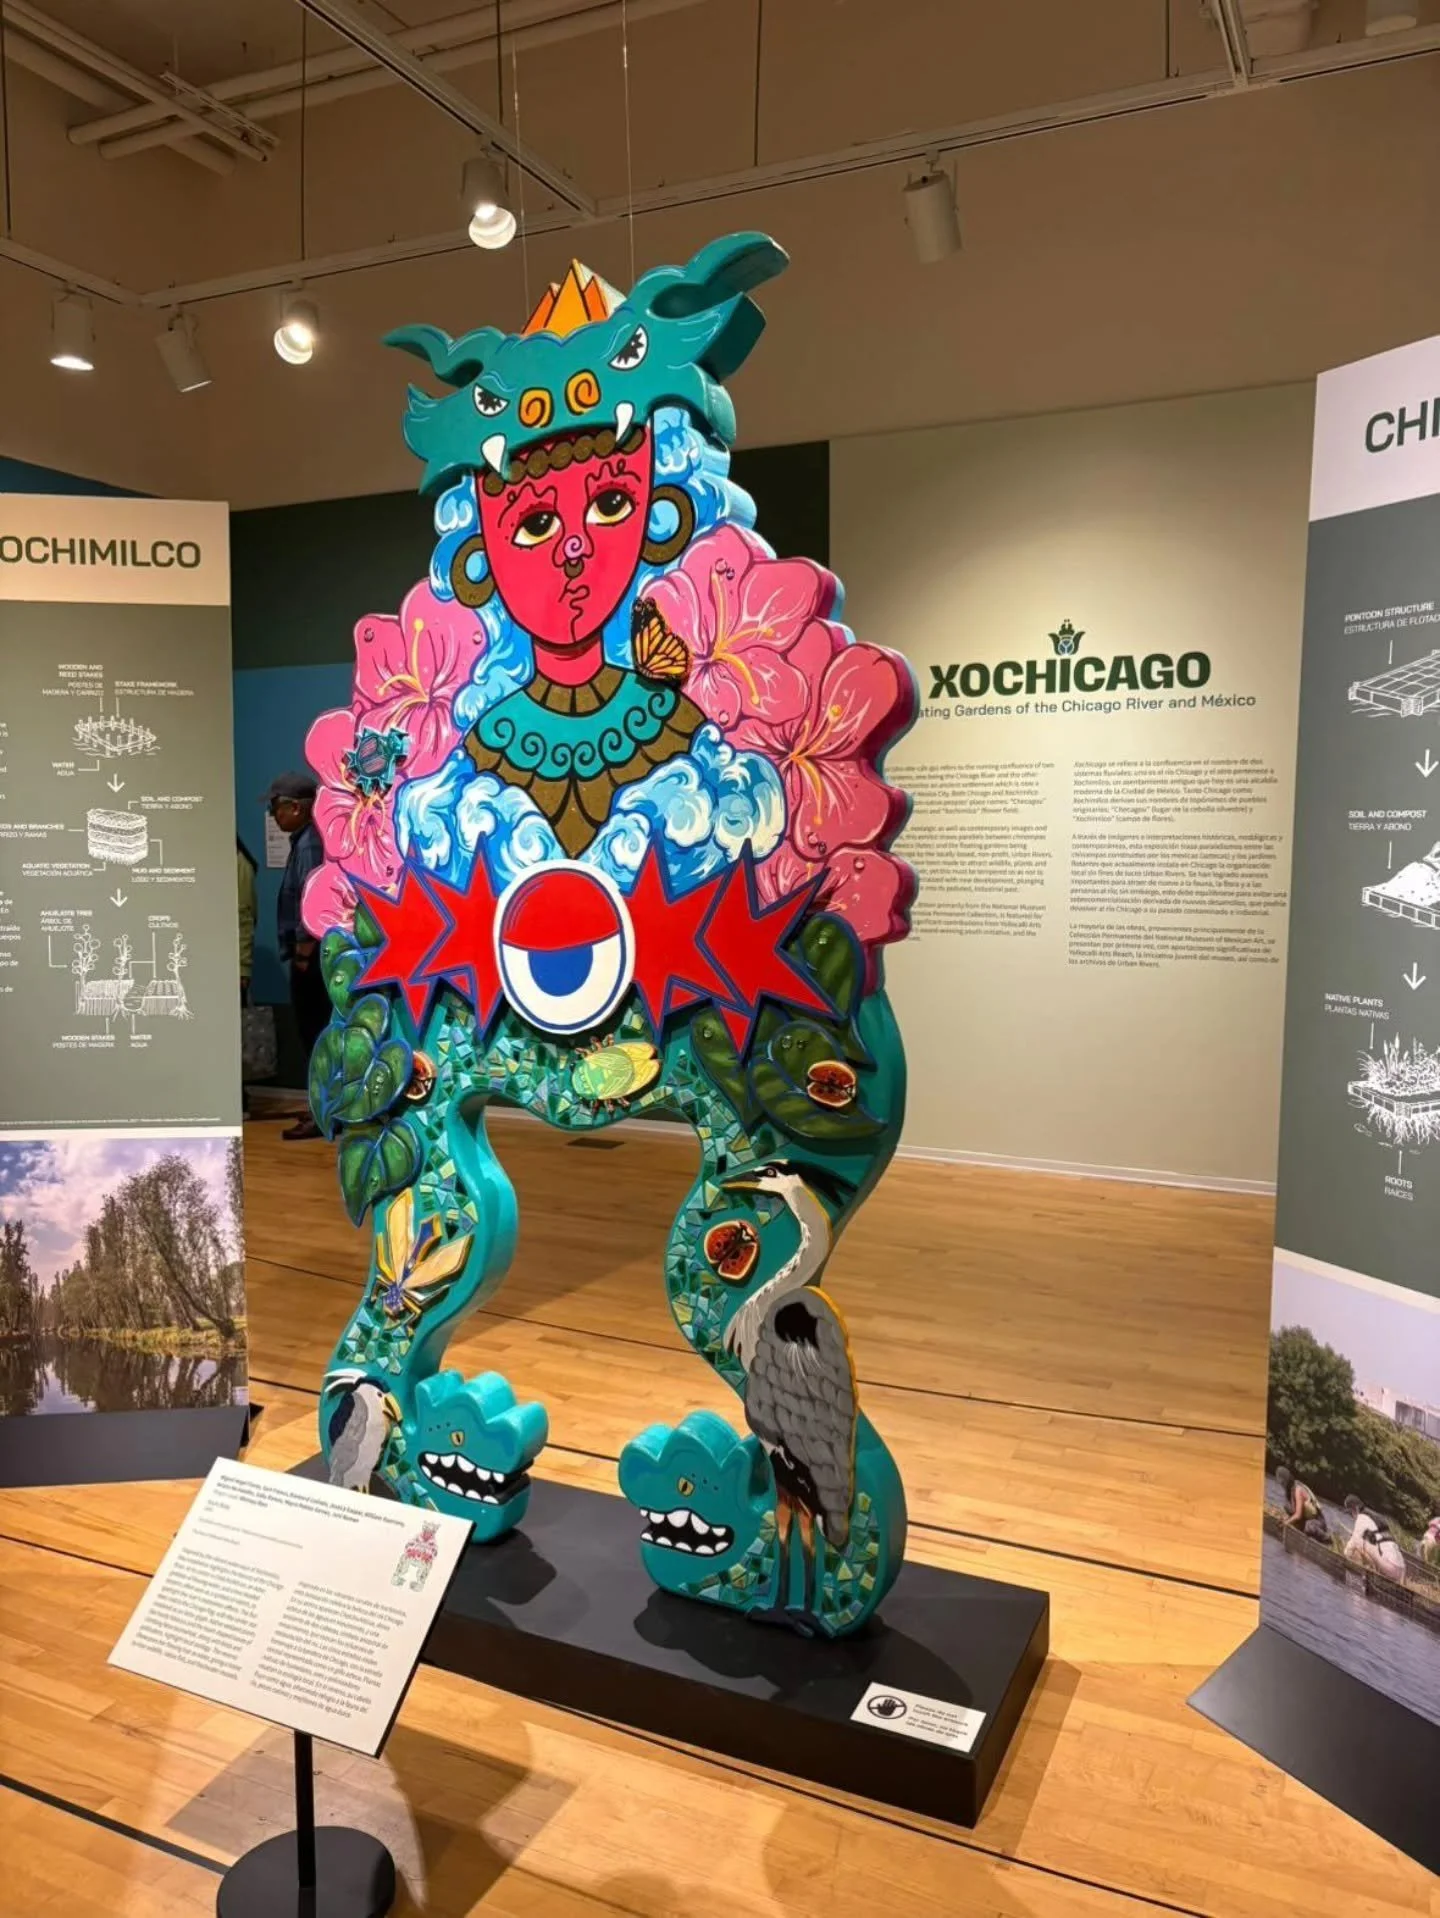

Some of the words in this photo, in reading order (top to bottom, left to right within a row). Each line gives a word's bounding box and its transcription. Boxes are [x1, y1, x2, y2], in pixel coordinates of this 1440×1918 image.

[0, 536, 201, 568] OCHIMILCO
[1344, 609, 1383, 622] PONTOON
[1384, 601, 1434, 617] STRUCTURE
[1344, 620, 1395, 635] ESTRUCTURA
[1397, 618, 1408, 628] DE
[929, 651, 1211, 699] XOCHICAGO
[954, 703, 1012, 717] Gardens
[1016, 702, 1031, 714] of
[1034, 700, 1058, 714] the
[1062, 697, 1122, 715] Chicago
[1126, 696, 1164, 711] River
[1168, 695, 1197, 709] and
[1201, 693, 1256, 708] México
[1348, 810, 1366, 818] SOIL
[1368, 810, 1385, 818] AND
[1386, 809, 1427, 818] COMPOST
[1348, 823, 1374, 831] TIERRA
[1383, 822, 1412, 831] ABONO
[1325, 993, 1351, 1004] NATIVE
[1353, 996, 1383, 1007] PLANTS
[1325, 1004, 1357, 1015] PLANTAS
[1358, 1008, 1389, 1020] NATIVAS
[1385, 1176, 1412, 1189] ROOTS
[1385, 1186, 1413, 1201] RAÍCES
